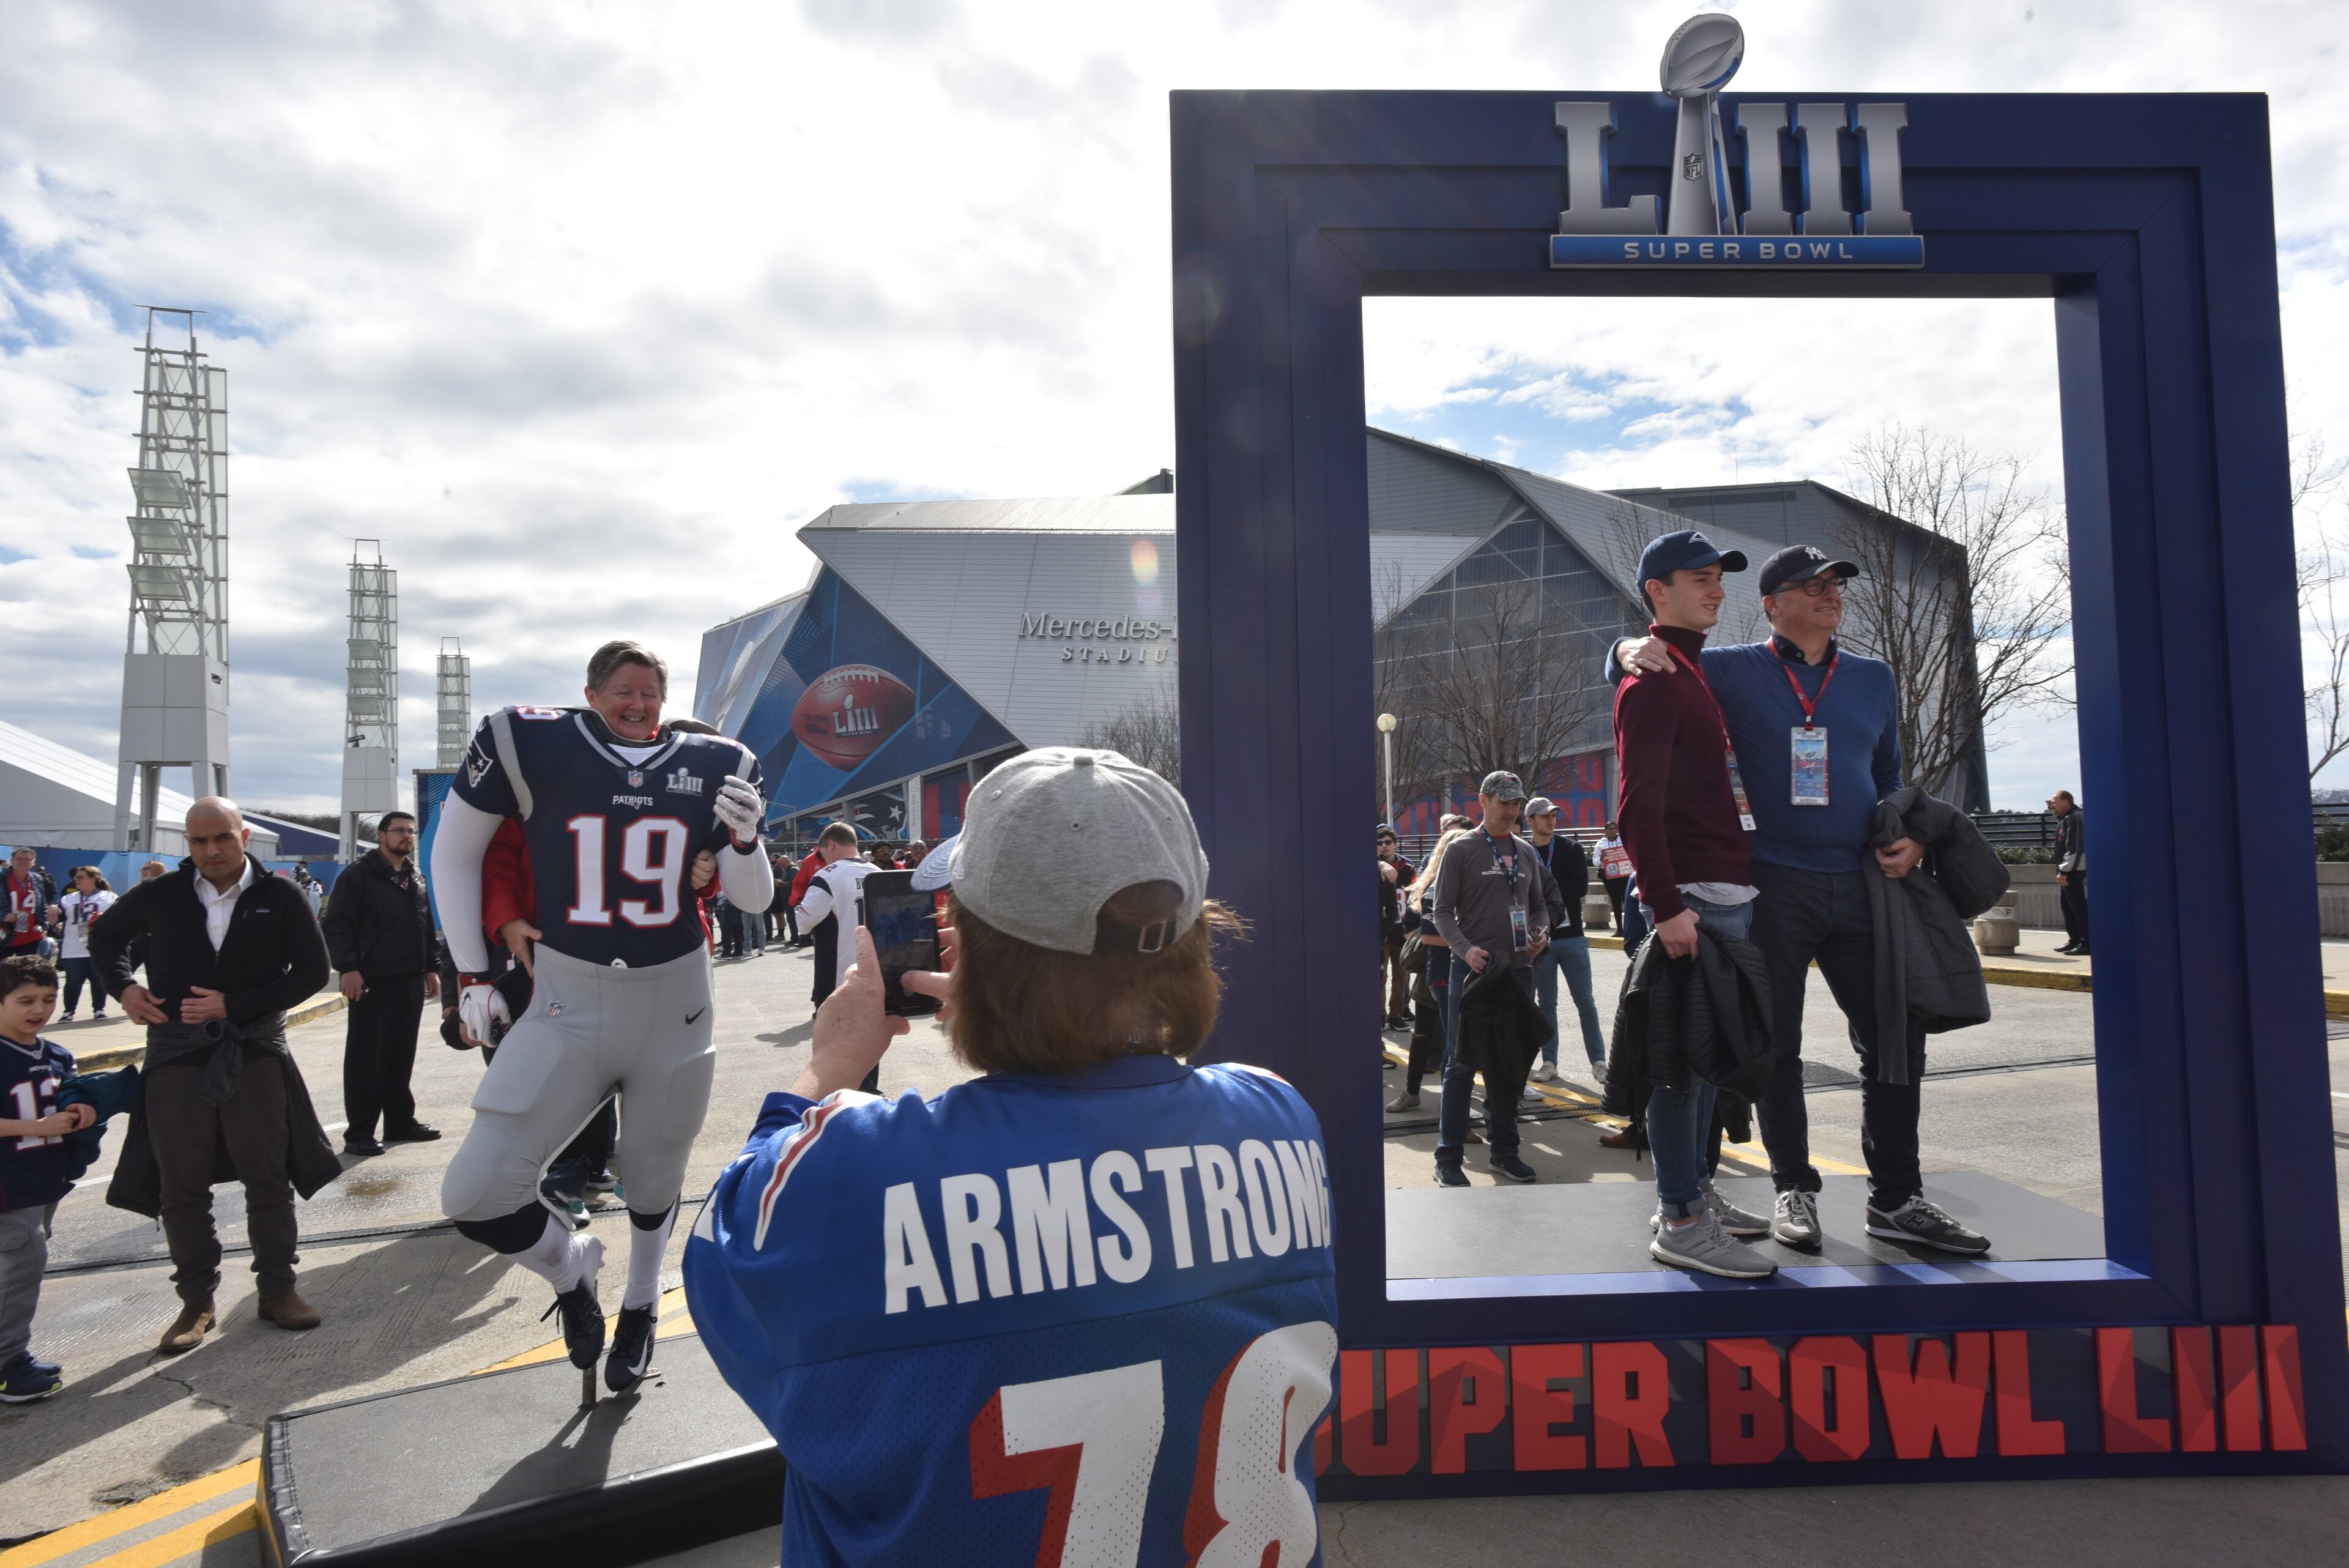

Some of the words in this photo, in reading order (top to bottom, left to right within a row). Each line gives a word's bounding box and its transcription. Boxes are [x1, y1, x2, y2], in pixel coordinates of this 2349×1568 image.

[1685, 163, 1700, 178] NFL
[1624, 242, 1741, 259] SUPER
[1759, 242, 1854, 259] BOWL
[1061, 646, 1178, 665] STADIU
[612, 795, 653, 806] PATRIOTS
[566, 814, 690, 929] 19
[10, 889, 37, 915] 14
[1313, 1340, 1676, 1477] UPER
[1705, 1329, 2066, 1466] BOWL
[2095, 1325, 2309, 1454] LIII
